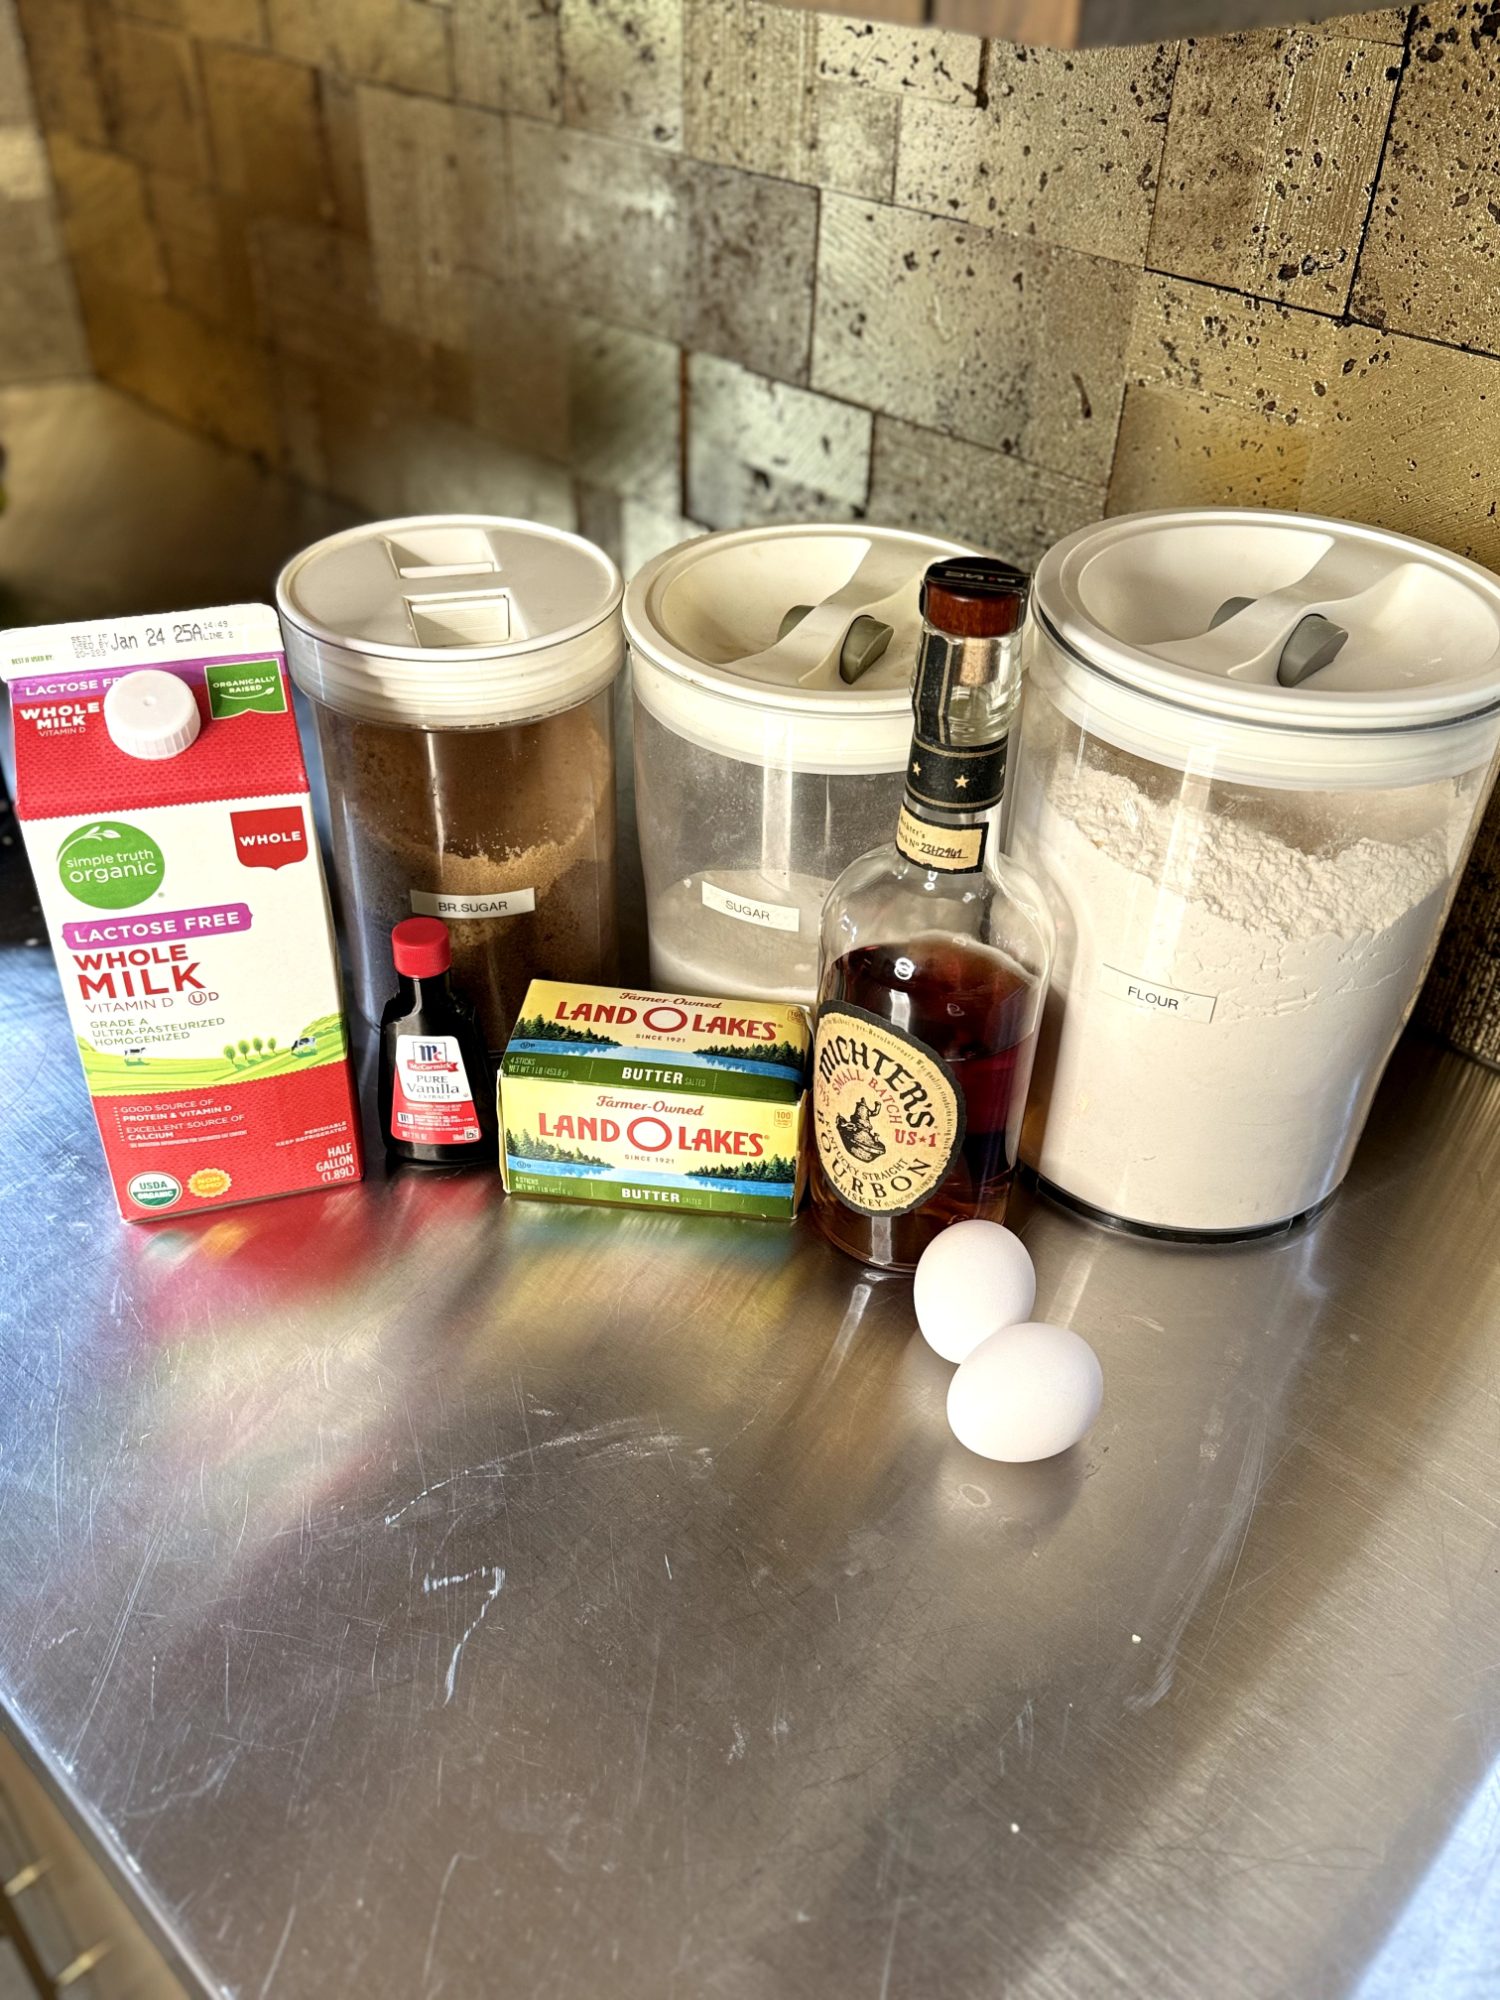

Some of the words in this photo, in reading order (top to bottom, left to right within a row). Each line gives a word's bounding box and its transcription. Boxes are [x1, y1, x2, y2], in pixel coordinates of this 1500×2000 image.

[111, 633, 138, 651] Jan
[145, 627, 165, 647] 24
[173, 624, 203, 643] 25A
[25, 679, 98, 697] LACTOSE
[212, 675, 276, 689] ORGANICALLY
[228, 684, 263, 694] RAISED
[20, 702, 100, 720] WHOLE
[36, 715, 86, 730] MILK
[38, 727, 77, 737] VITAMIN
[239, 830, 302, 847] WHOLE
[65, 853, 114, 870] simple
[116, 849, 154, 863] truth
[69, 861, 158, 884] organic
[725, 900, 770, 921] SUGAR
[73, 919, 177, 944] LACTOSE
[185, 911, 240, 931] FREE
[73, 944, 189, 971] WHOLE
[77, 962, 206, 1000] MILK
[85, 998, 157, 1014] VITAMIN
[162, 997, 174, 1008] D
[619, 992, 723, 1010] Farmer-Owned
[1128, 986, 1179, 1011] FLOUR
[90, 1017, 136, 1029] GRADE
[139, 1017, 149, 1026] A
[92, 1017, 225, 1037] ULTRA-PASTEURIZED
[555, 1001, 638, 1025] LAND
[692, 1014, 778, 1041] LAKES
[94, 1031, 190, 1046] HOMOGENIZED
[635, 1033, 663, 1042] SINCE
[666, 1036, 686, 1044] 1921
[509, 1065, 520, 1073] NET
[515, 1057, 536, 1066] STICKS
[416, 1075, 448, 1083] PURE
[621, 1066, 684, 1085] BUTTER
[685, 1076, 706, 1087] SALTED
[819, 1035, 935, 1129] MICHTER'S
[832, 1068, 864, 1096] SMALL
[407, 1082, 459, 1094] Vanilla
[121, 1105, 152, 1113] GOOD
[155, 1100, 197, 1111] SOURCE
[200, 1098, 214, 1106] OF
[596, 1095, 704, 1116] Farmer-Owned
[868, 1078, 904, 1125] BATCH
[122, 1113, 167, 1122] PROTEIN
[179, 1107, 221, 1118] VITAMIN
[776, 1111, 791, 1119] 100
[126, 1123, 183, 1133] EXCELLENT
[187, 1117, 228, 1129] SOURCE
[127, 1132, 174, 1140] CALCIUM
[538, 1112, 620, 1142] LAND
[679, 1126, 764, 1157] LAKES
[327, 1142, 352, 1158] HALF
[825, 1121, 859, 1176] KENTUCKY
[316, 1154, 354, 1172] GALLON
[625, 1154, 651, 1162] SINCE
[321, 1165, 355, 1183] (1.89L)
[862, 1158, 909, 1182] STRAIGHT
[139, 1181, 168, 1190] USDA
[833, 1175, 882, 1207] WHISKEY
[137, 1190, 174, 1200] ORGANIC
[621, 1188, 680, 1203] BUTTER
